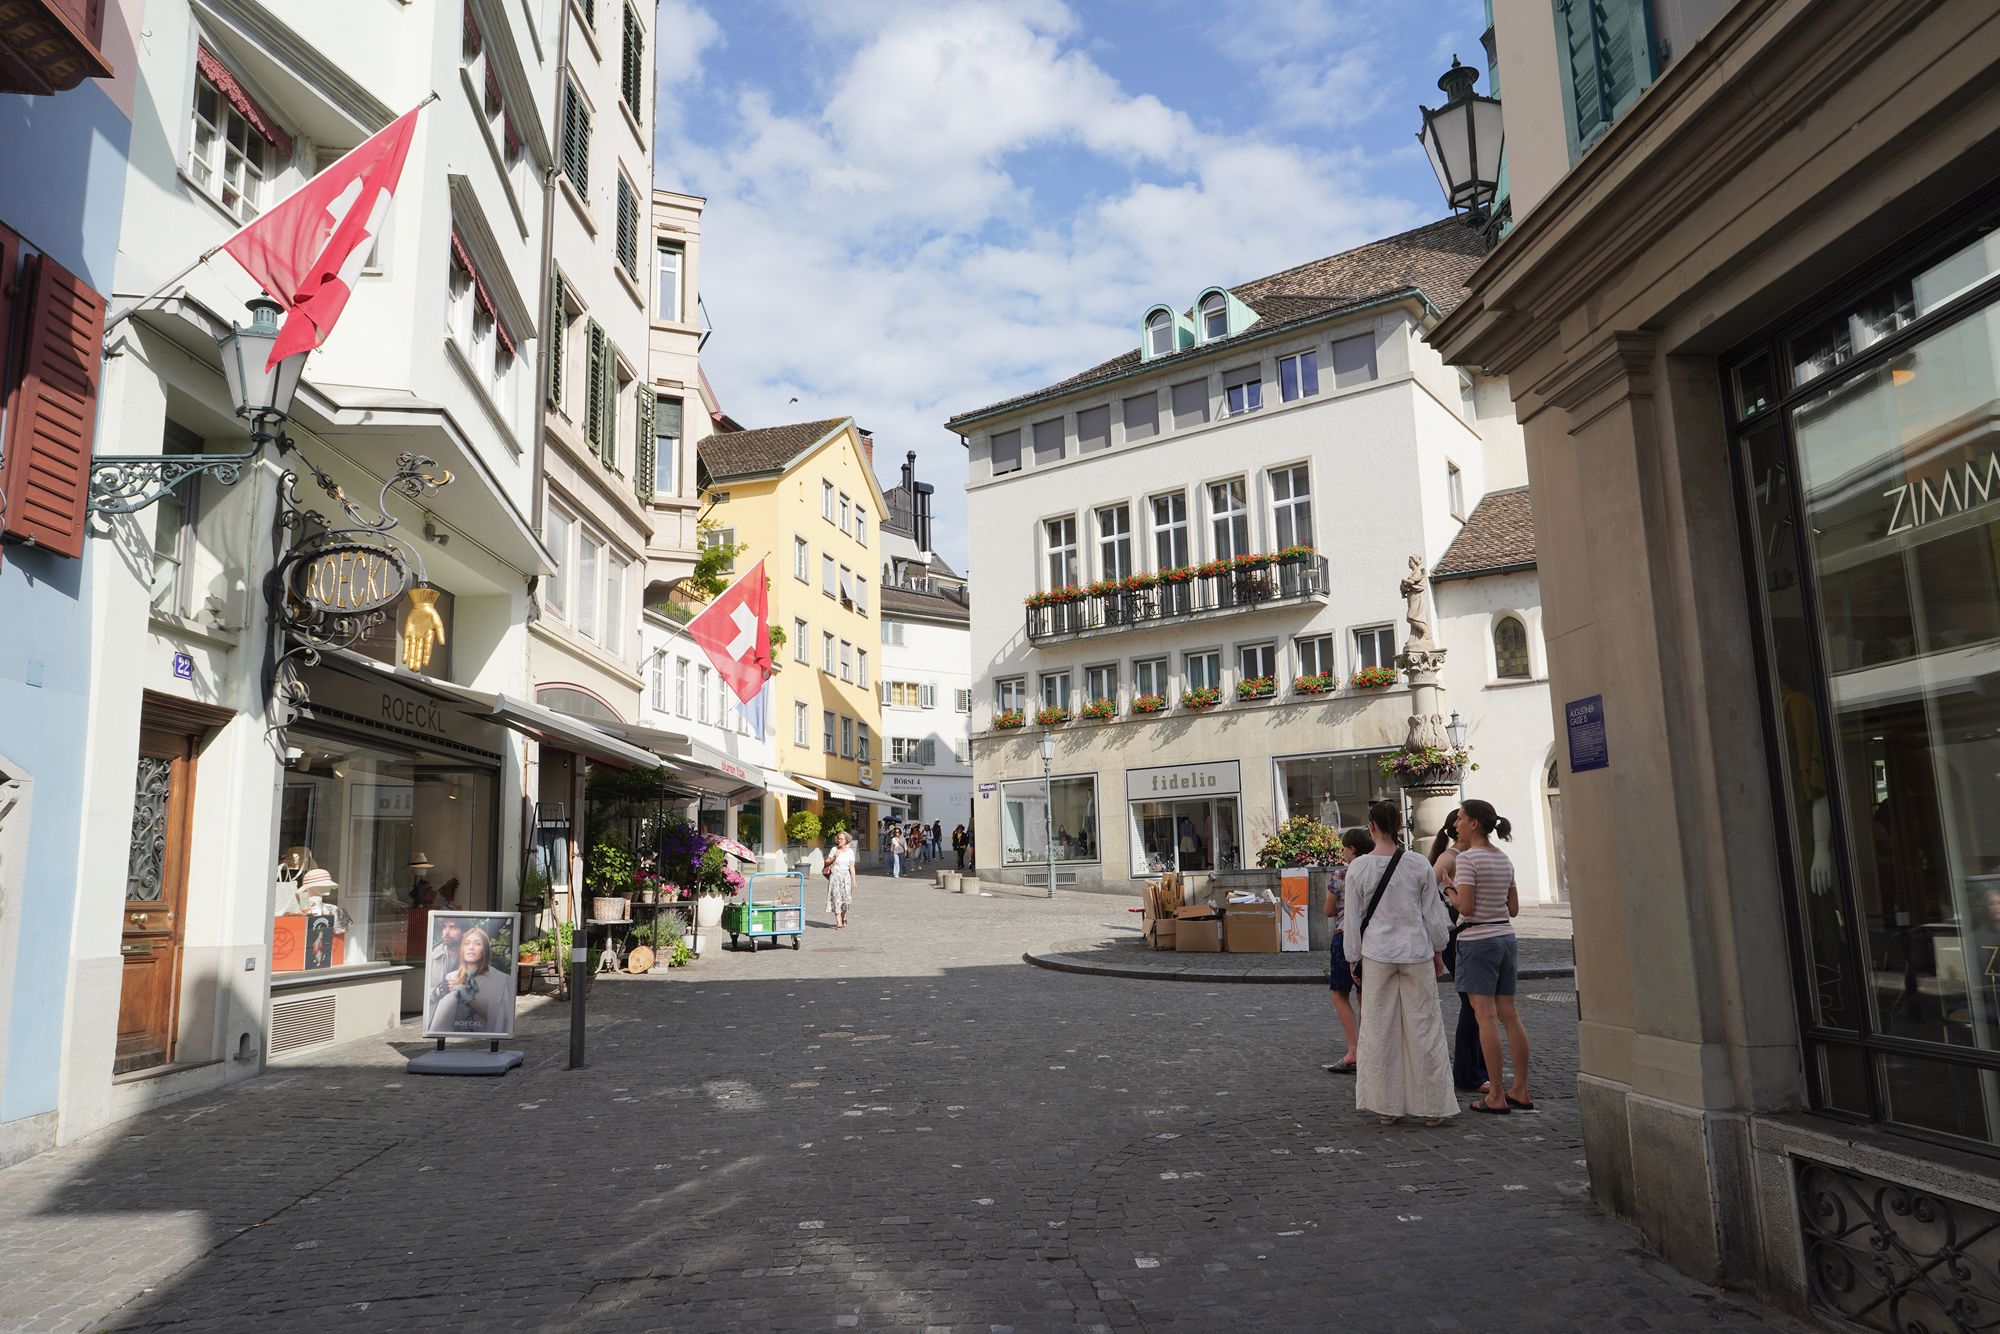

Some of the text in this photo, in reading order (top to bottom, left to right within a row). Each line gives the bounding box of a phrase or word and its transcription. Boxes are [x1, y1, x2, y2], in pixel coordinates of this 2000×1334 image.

[306, 550, 393, 608] ROECKL
[177, 656, 190, 676] 22
[382, 694, 446, 733] ROECKL
[894, 777, 915, 785] BÖRSE
[1152, 772, 1217, 791] fidelio
